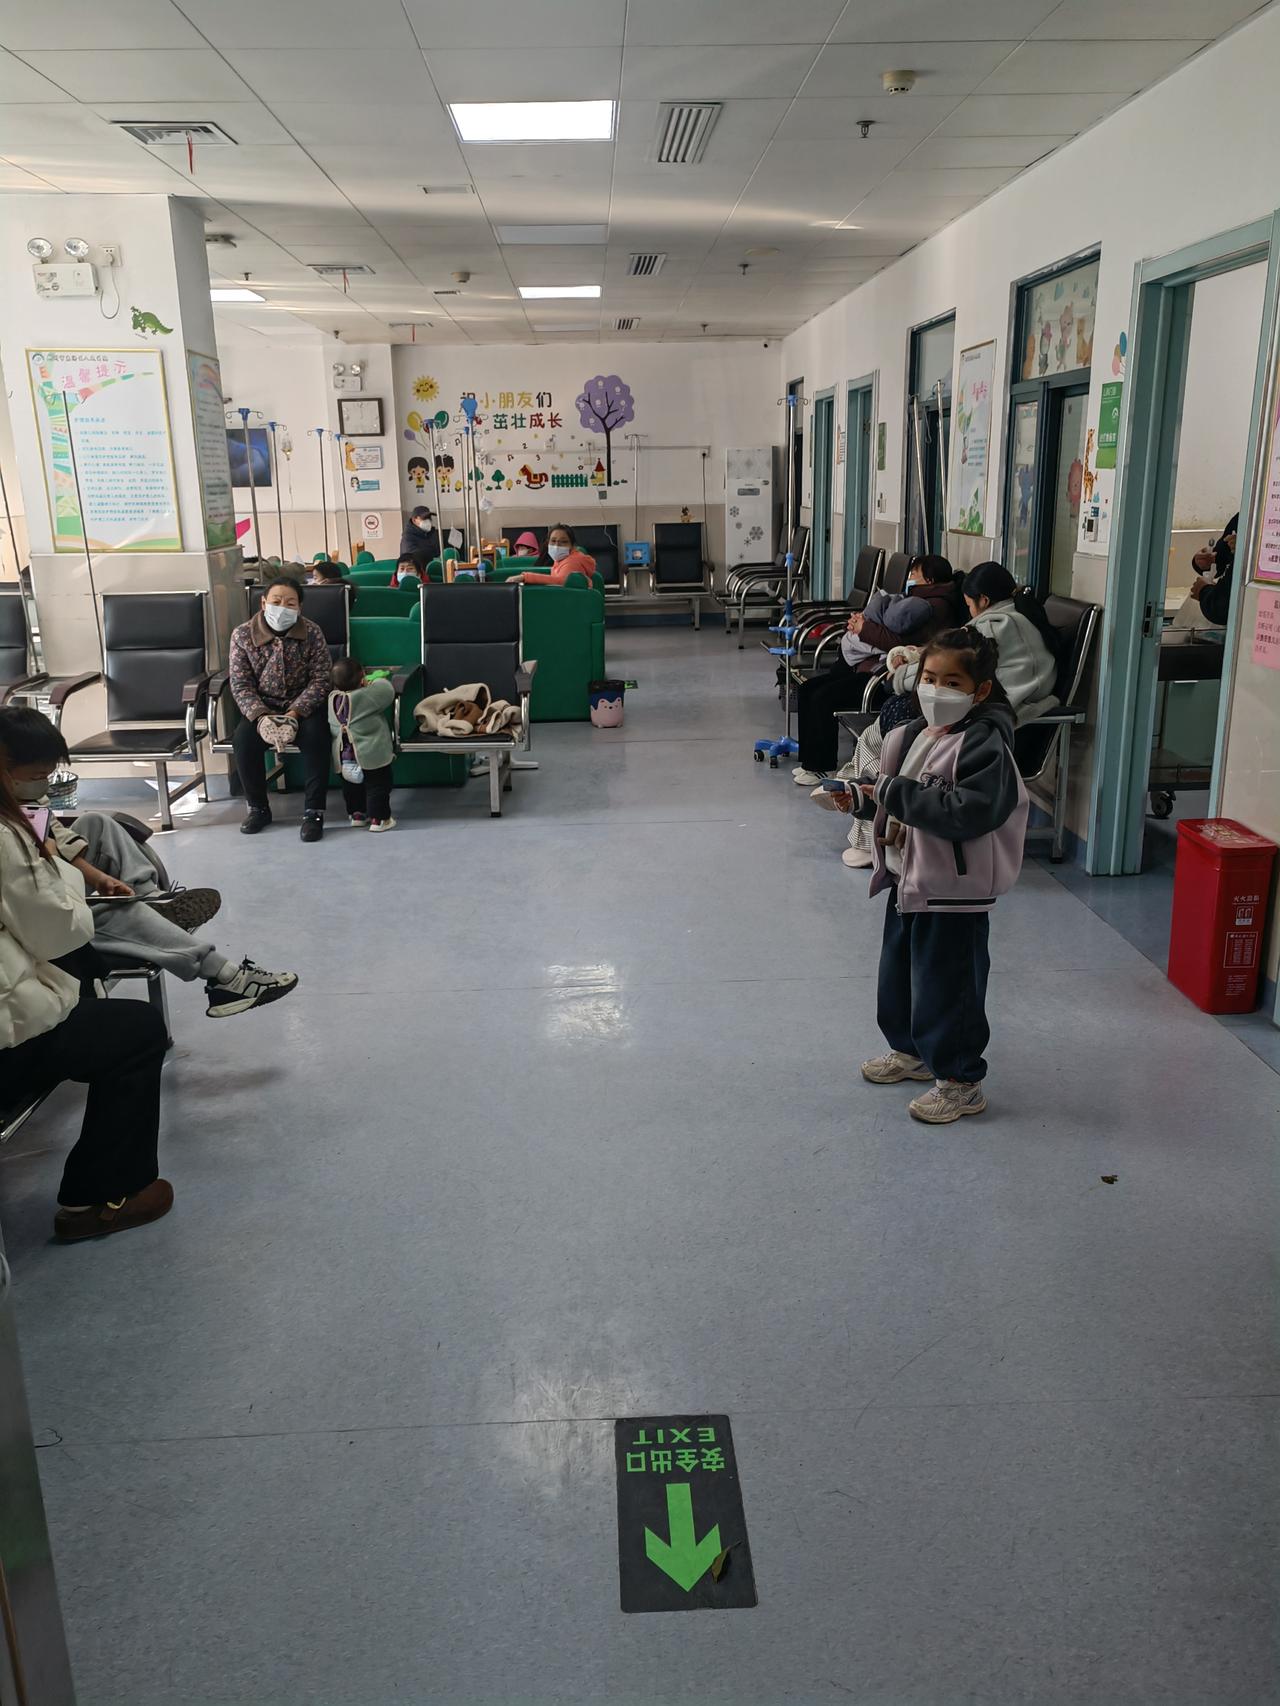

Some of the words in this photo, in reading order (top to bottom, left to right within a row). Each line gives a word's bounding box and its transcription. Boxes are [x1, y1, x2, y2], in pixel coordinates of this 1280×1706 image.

[61, 360, 127, 389] 温馨提示
[493, 412, 563, 430] 茁壮成长
[632, 1427, 716, 1445] EXIT
[626, 1447, 725, 1474] 安全出口
